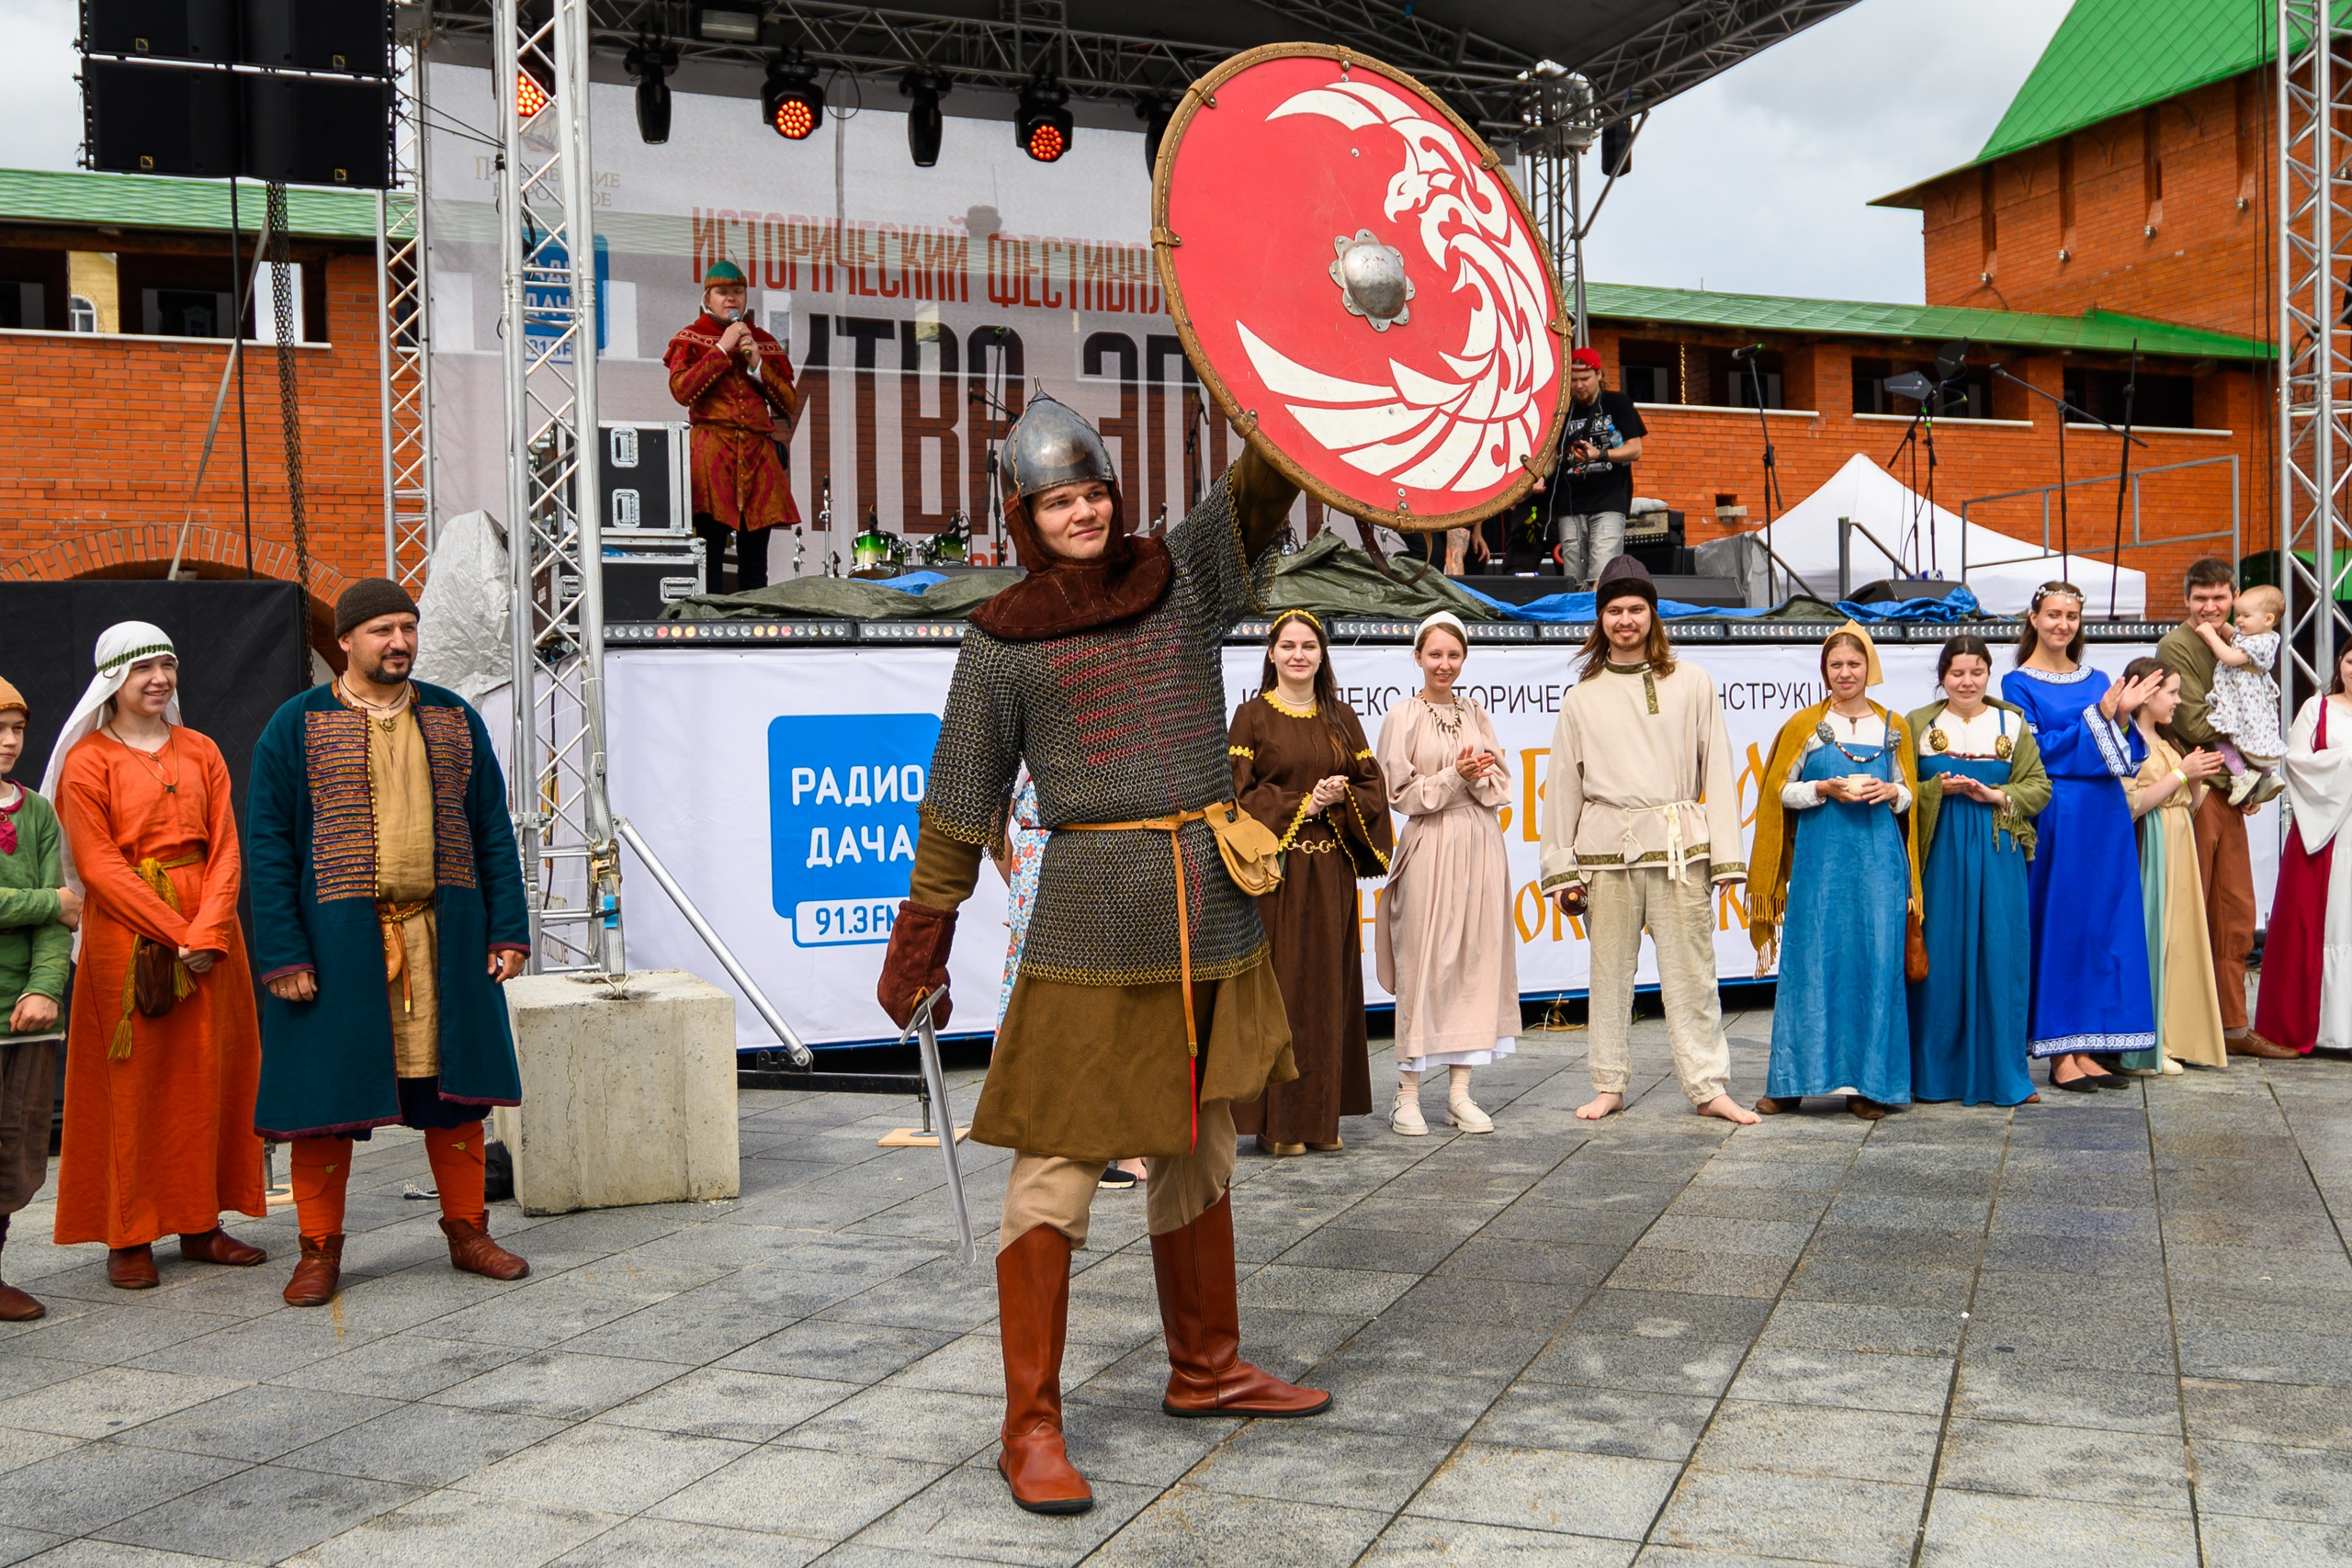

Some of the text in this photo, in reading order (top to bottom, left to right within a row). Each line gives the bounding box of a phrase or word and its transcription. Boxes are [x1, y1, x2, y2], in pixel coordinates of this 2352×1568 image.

[692, 207, 1171, 315] ИСТОРИЧЕСКИЙ ФЕСТИВАЛ
[700, 305, 1025, 536] ИТВА
[791, 764, 925, 807] РАДИО
[806, 824, 916, 869] ДАЧА
